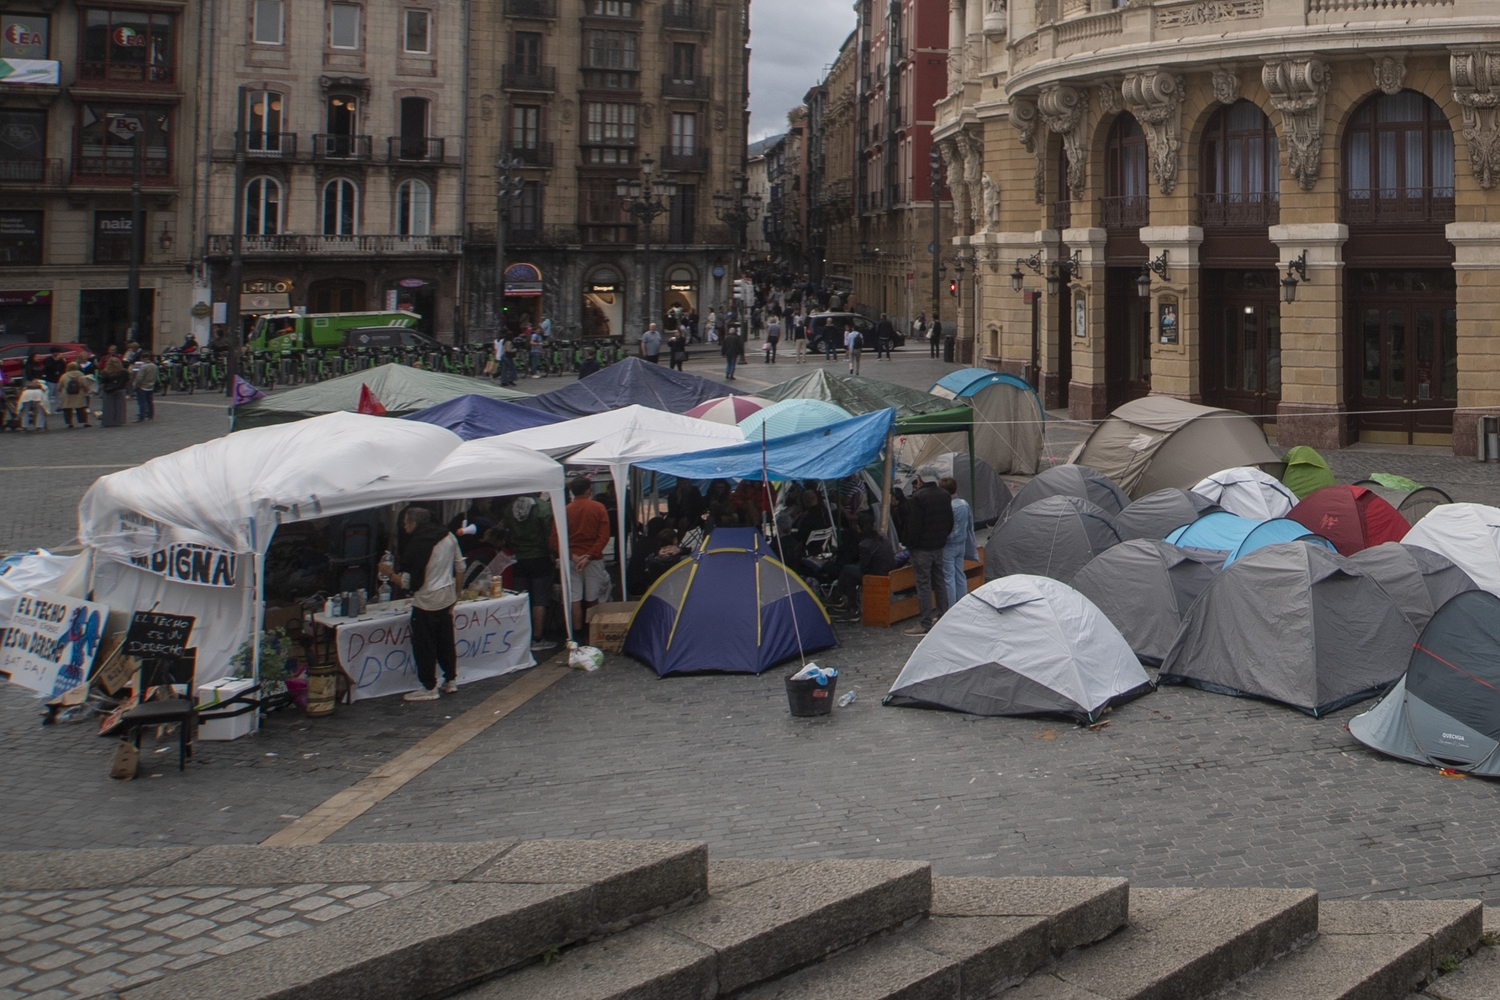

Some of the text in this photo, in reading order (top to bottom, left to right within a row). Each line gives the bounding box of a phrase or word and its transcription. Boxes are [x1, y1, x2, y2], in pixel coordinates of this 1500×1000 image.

[19, 32, 43, 45] EA
[126, 34, 146, 47] EA
[116, 118, 139, 132] BG
[100, 217, 133, 229] naiz
[254, 282, 287, 293] TILO
[151, 548, 236, 586] DIGNA!
[16, 596, 33, 616] EL
[33, 599, 68, 624] TECHO
[135, 613, 190, 629] EL TECHO
[4, 626, 65, 664] ES UN DERECHO
[128, 640, 184, 657] DERECHO
[1441, 732, 1465, 741] QUECHUA
